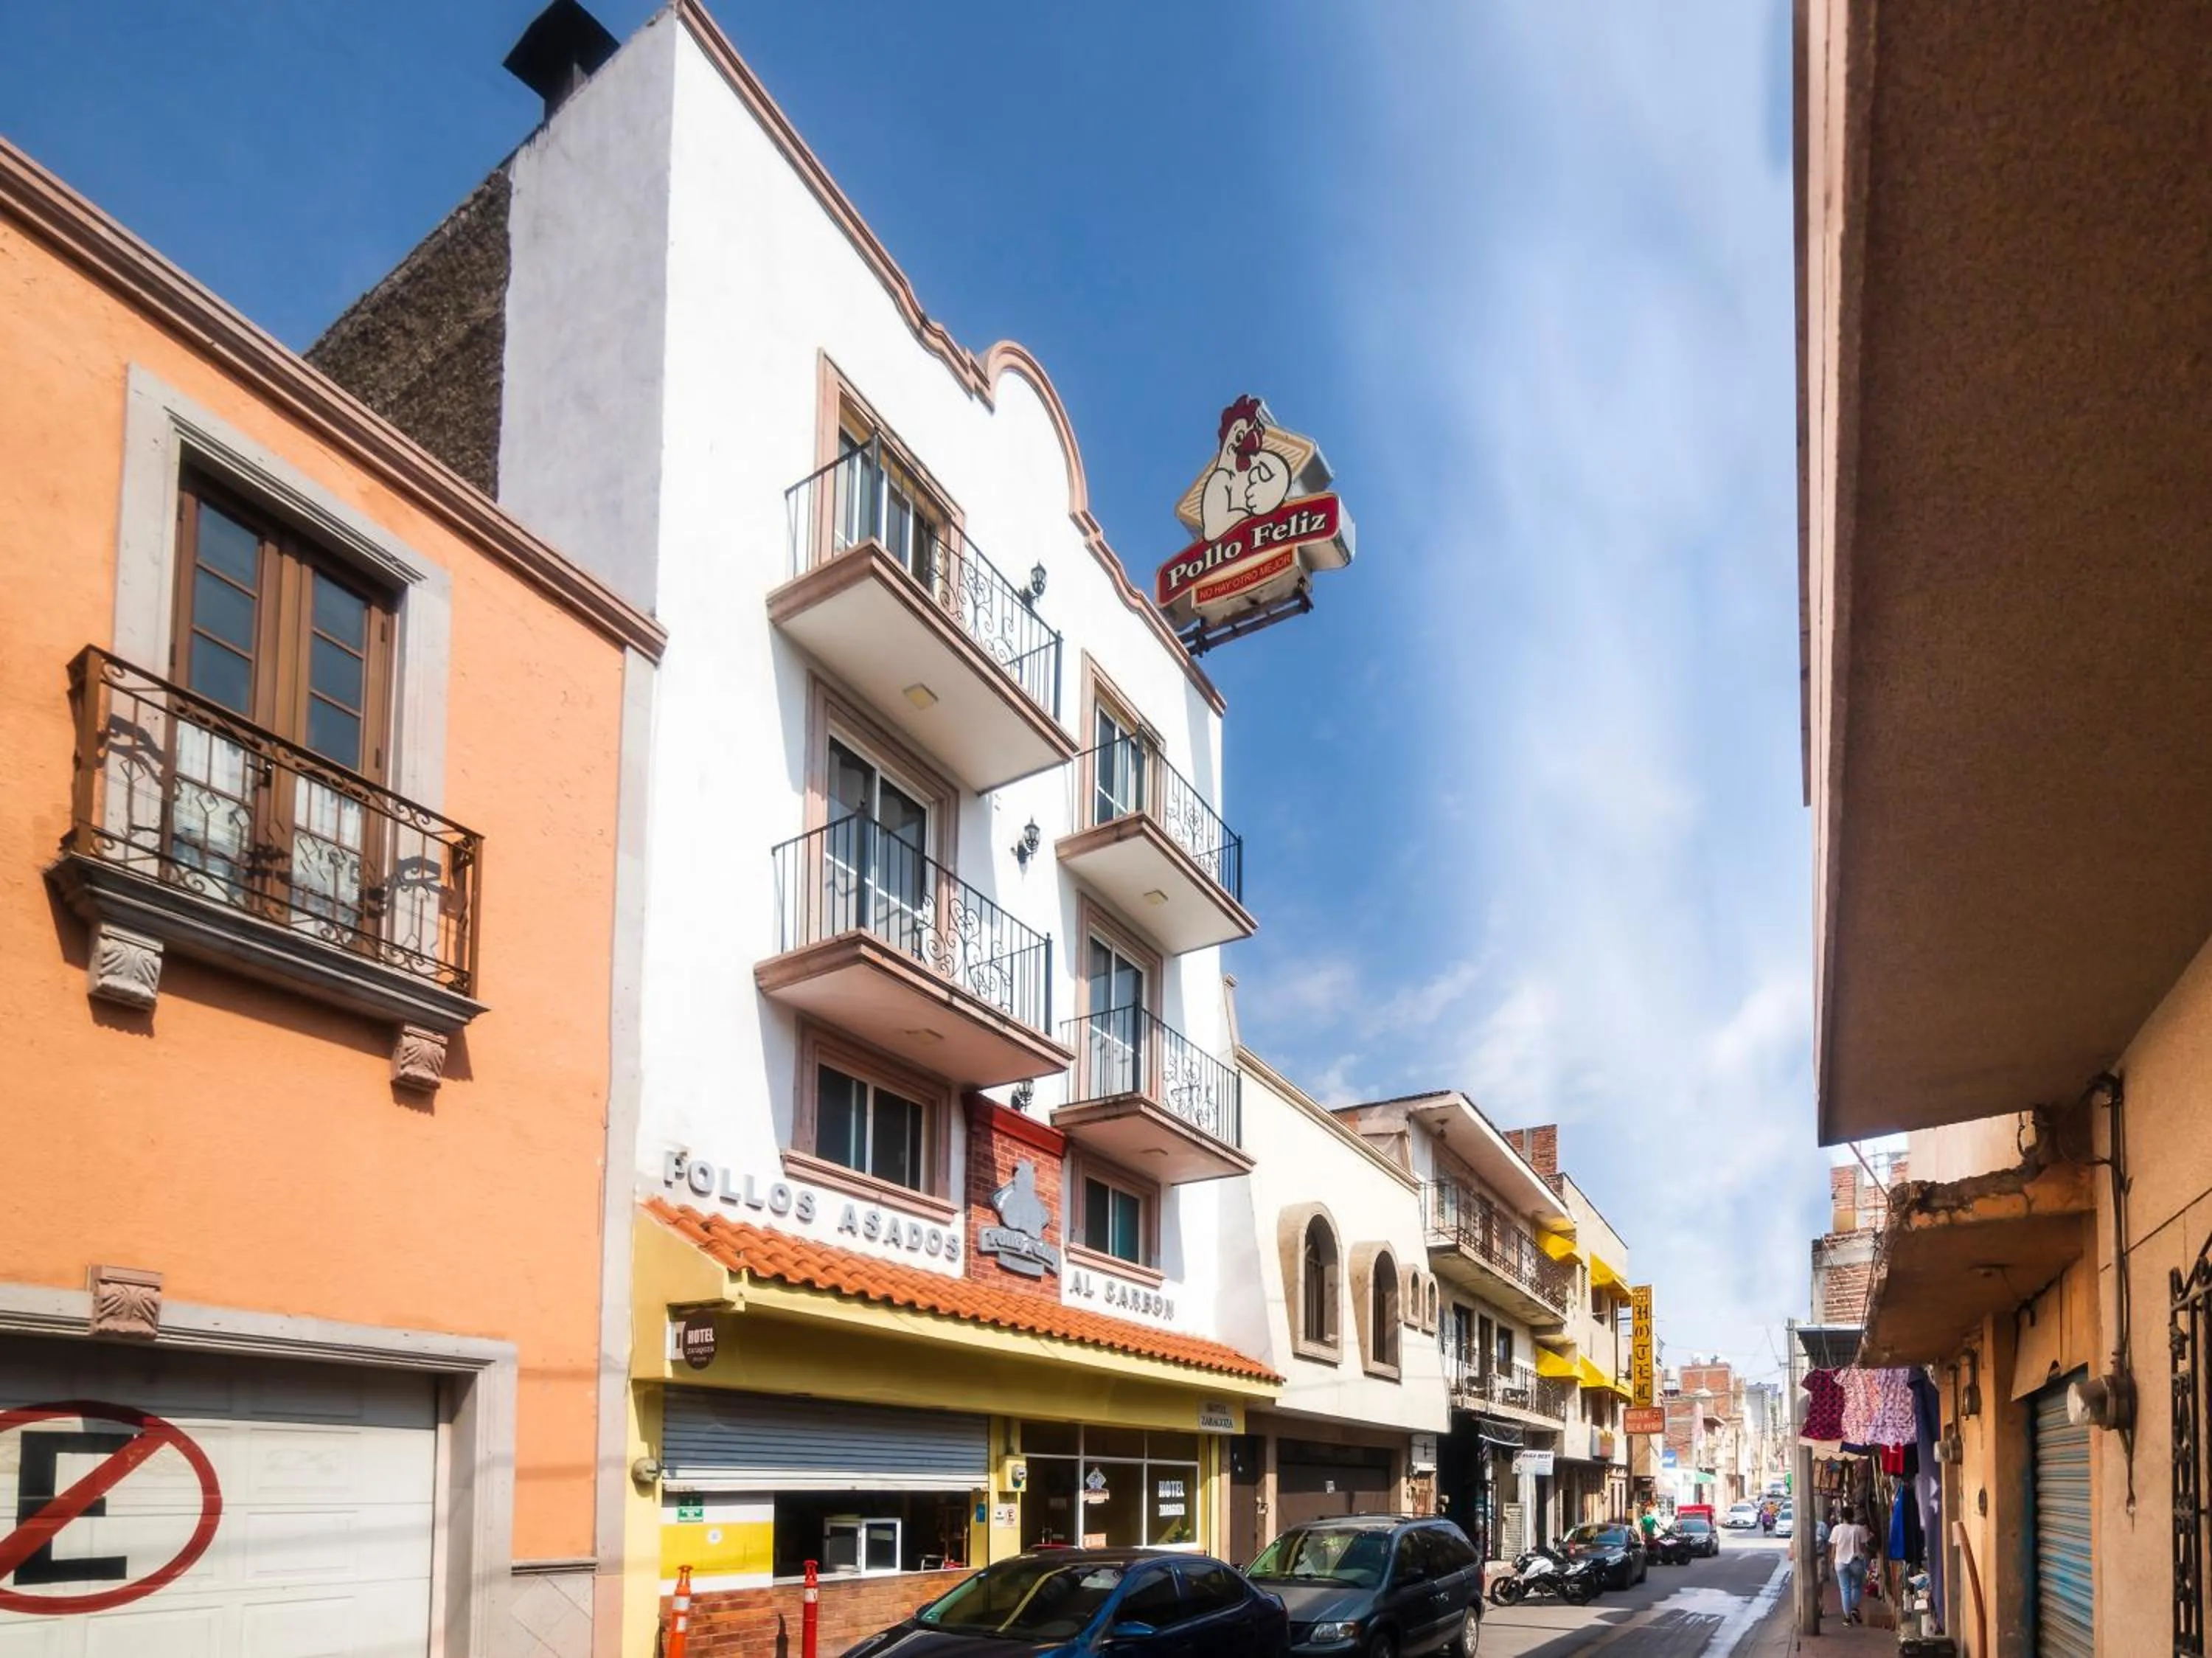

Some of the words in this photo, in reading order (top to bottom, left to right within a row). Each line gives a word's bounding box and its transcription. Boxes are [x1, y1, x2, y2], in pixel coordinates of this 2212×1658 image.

[1167, 540, 1243, 591] Pollo
[1251, 512, 1326, 550] Feliz
[1199, 589, 1213, 601] NO
[1214, 580, 1231, 594] HAY
[1231, 571, 1259, 589] OTRO
[1259, 554, 1291, 576] MEJOR
[664, 1150, 817, 1224] POLLOS
[838, 1203, 961, 1263] ASADOS
[1068, 1271, 1095, 1299] AL
[686, 1327, 714, 1345] HOTEL
[1634, 1304, 1650, 1400] HOTEL
[1158, 1480, 1185, 1498] HOTEL
